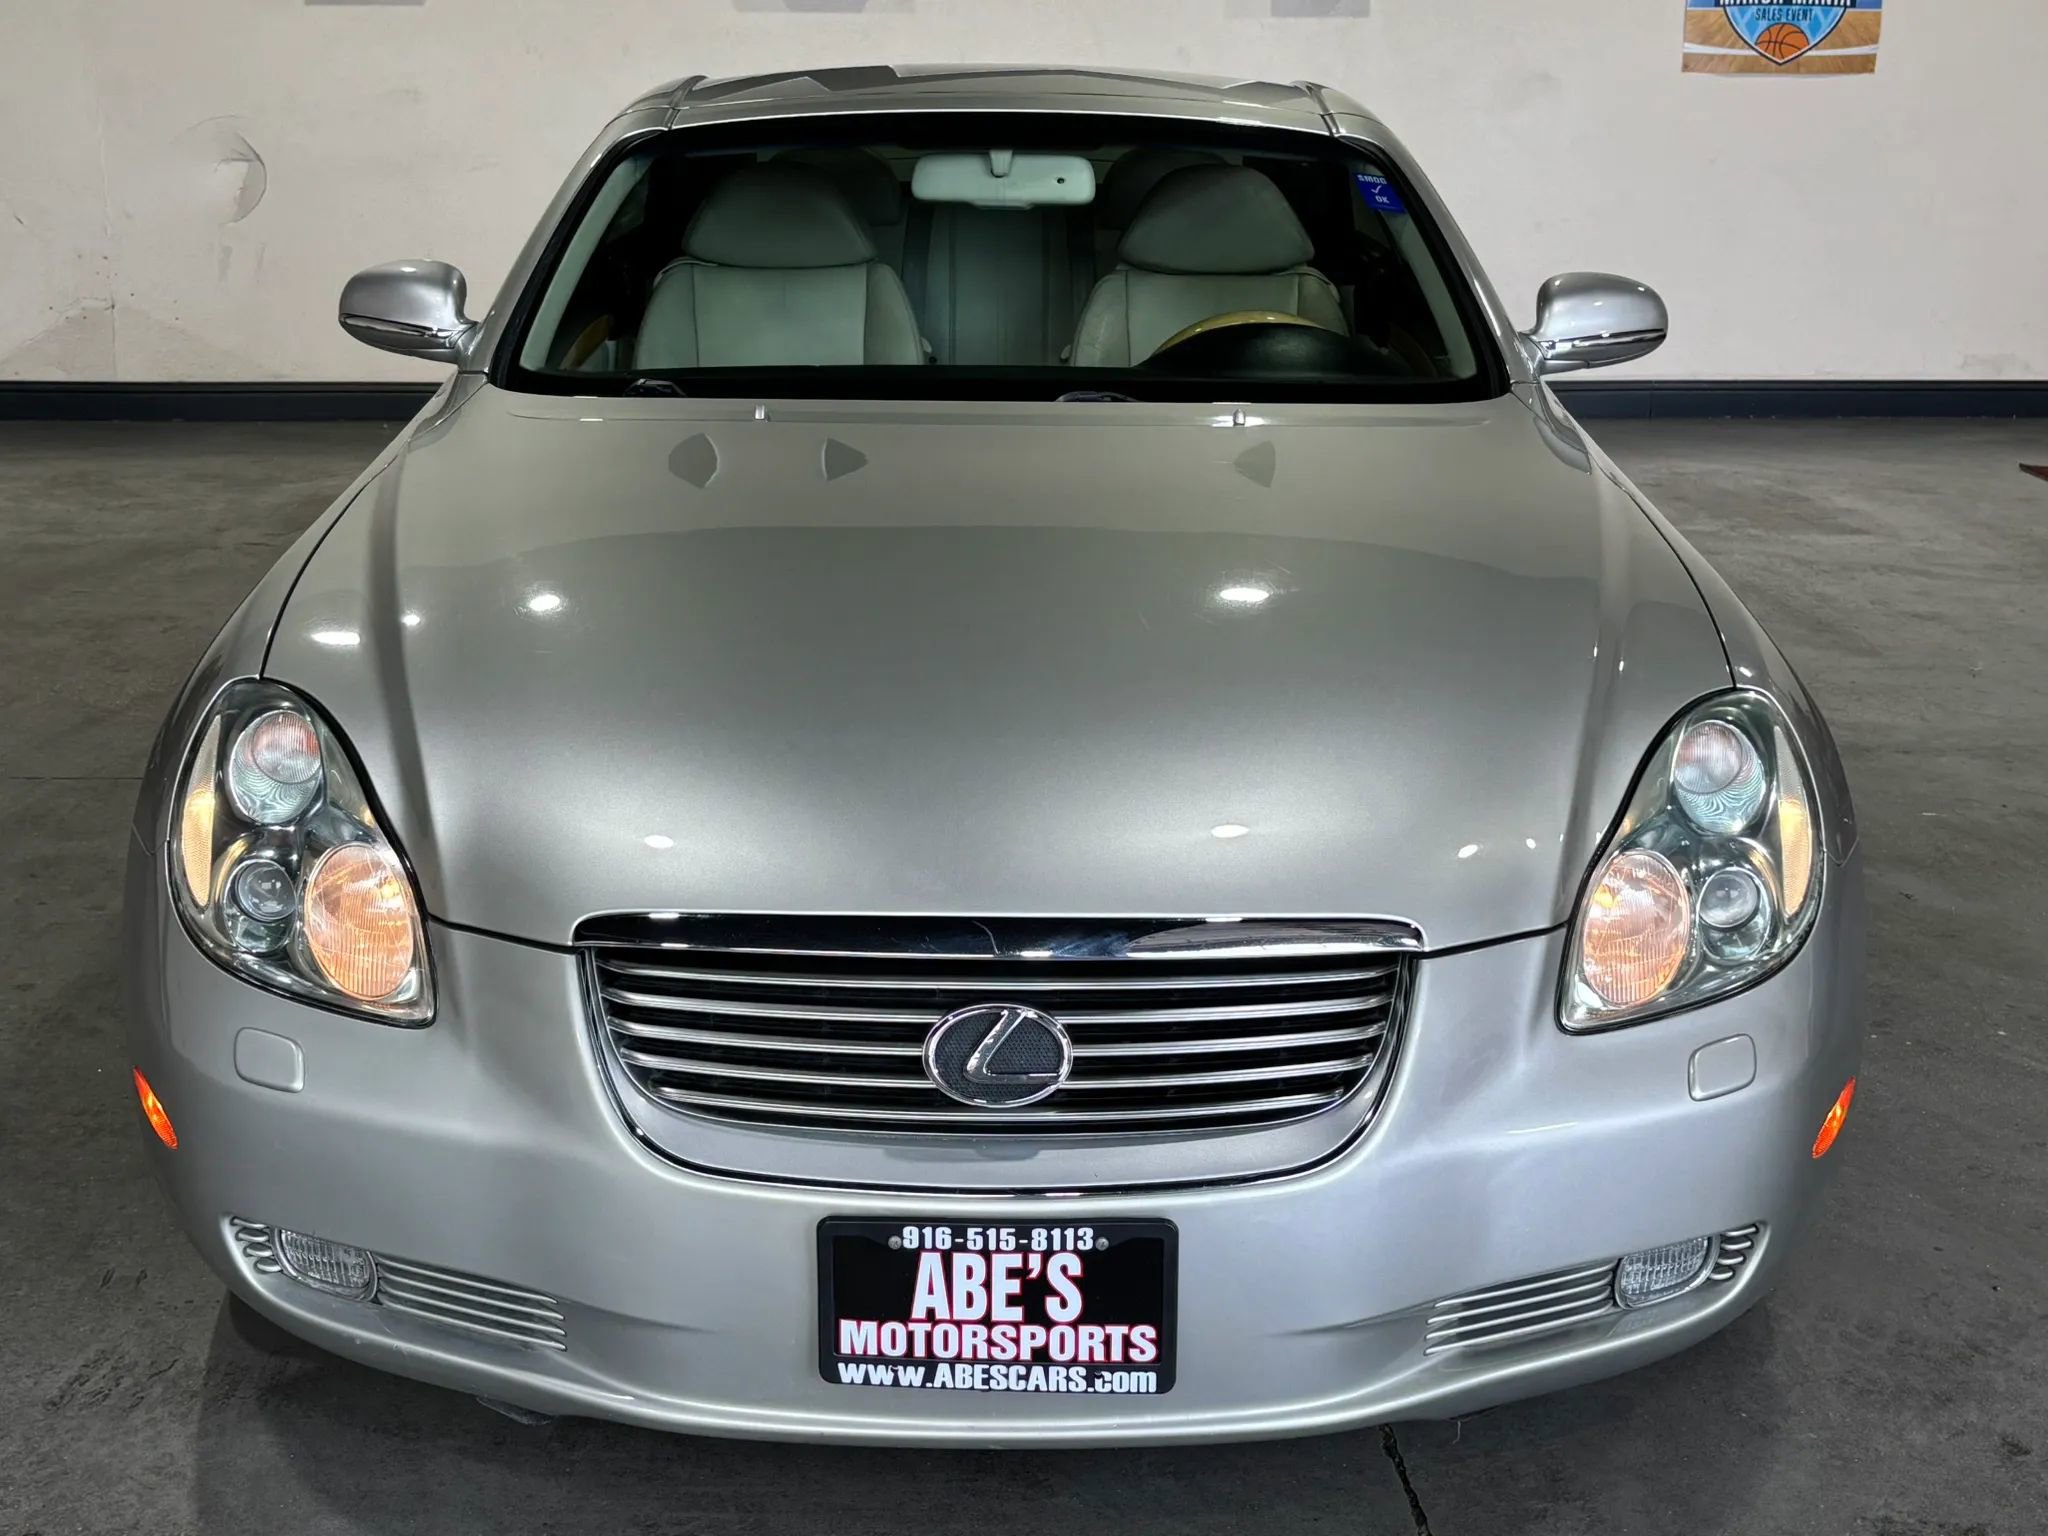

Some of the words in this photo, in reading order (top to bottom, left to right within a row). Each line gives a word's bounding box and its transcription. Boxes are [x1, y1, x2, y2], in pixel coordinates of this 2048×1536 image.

[1755, 8, 1783, 21] SALES
[1786, 8, 1813, 21] EVENT
[1375, 195, 1390, 204] OK
[902, 1226, 1095, 1251] 916-515-8113
[910, 1251, 1084, 1322] ABE'S
[838, 1319, 1158, 1363] MOTORSPORTS
